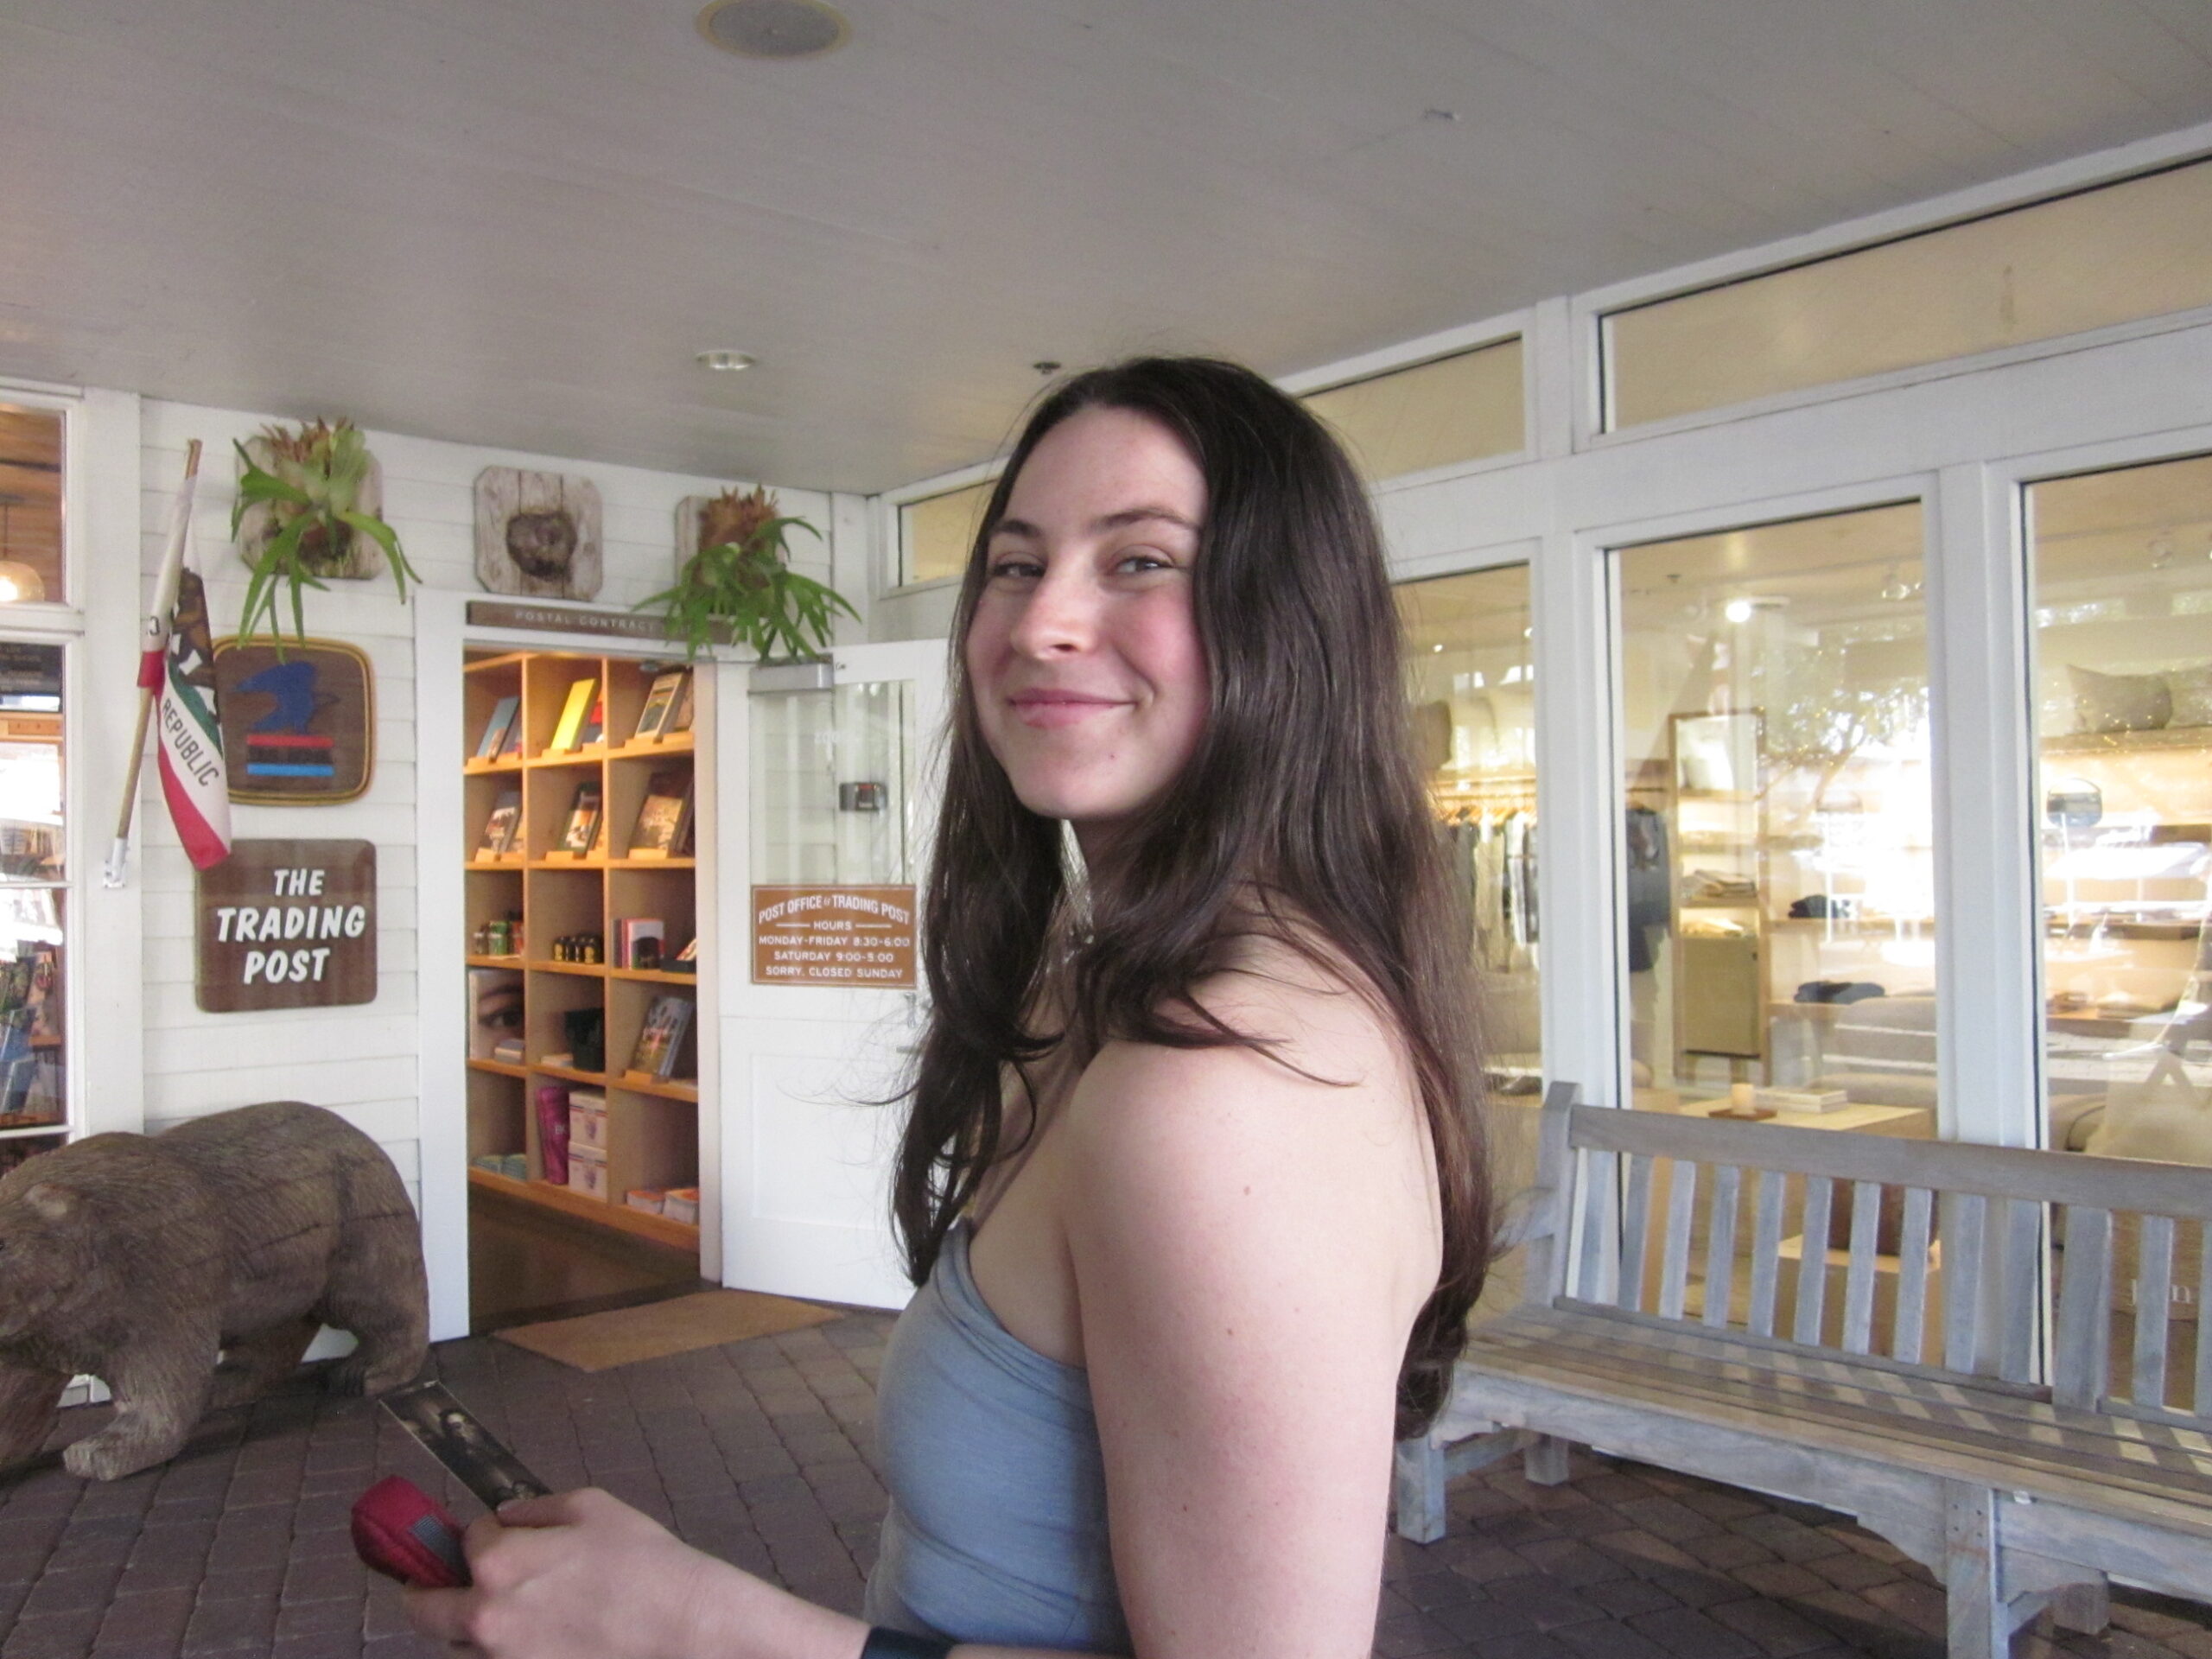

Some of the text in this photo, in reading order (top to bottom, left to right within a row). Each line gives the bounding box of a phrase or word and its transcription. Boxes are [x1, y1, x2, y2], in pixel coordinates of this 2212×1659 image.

[516, 610, 655, 632] POSTAL CONTRACT
[163, 697, 219, 787] REPUBLIC
[274, 868, 325, 896] THE
[759, 902, 785, 925] POST
[787, 895, 822, 913] OFFICE
[832, 894, 879, 914] TRADING
[880, 902, 910, 925] POST
[217, 906, 366, 942] TRADING
[813, 921, 852, 931] HOURS
[243, 947, 331, 985] POST
[774, 951, 830, 962] SATURDAY
[809, 967, 852, 977] CLOSED
[857, 968, 903, 979] SUNDAY
